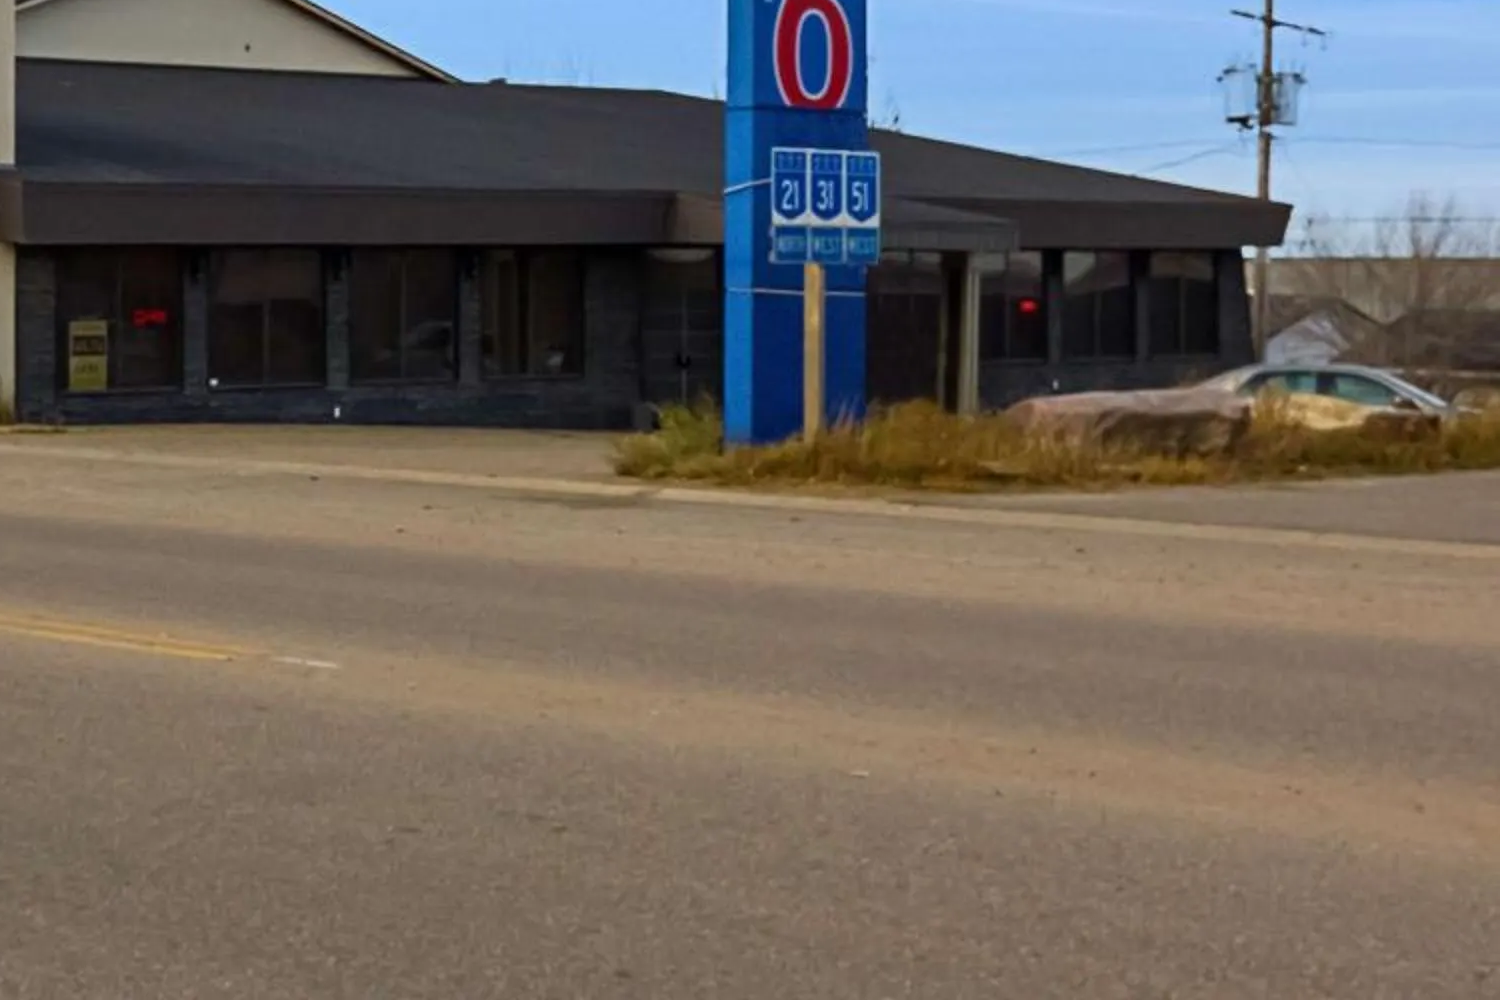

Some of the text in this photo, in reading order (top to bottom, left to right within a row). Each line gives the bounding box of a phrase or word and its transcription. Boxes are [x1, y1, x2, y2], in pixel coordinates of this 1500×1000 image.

[781, 179, 799, 211] 21
[816, 180, 834, 212] 31
[851, 180, 869, 212] 51
